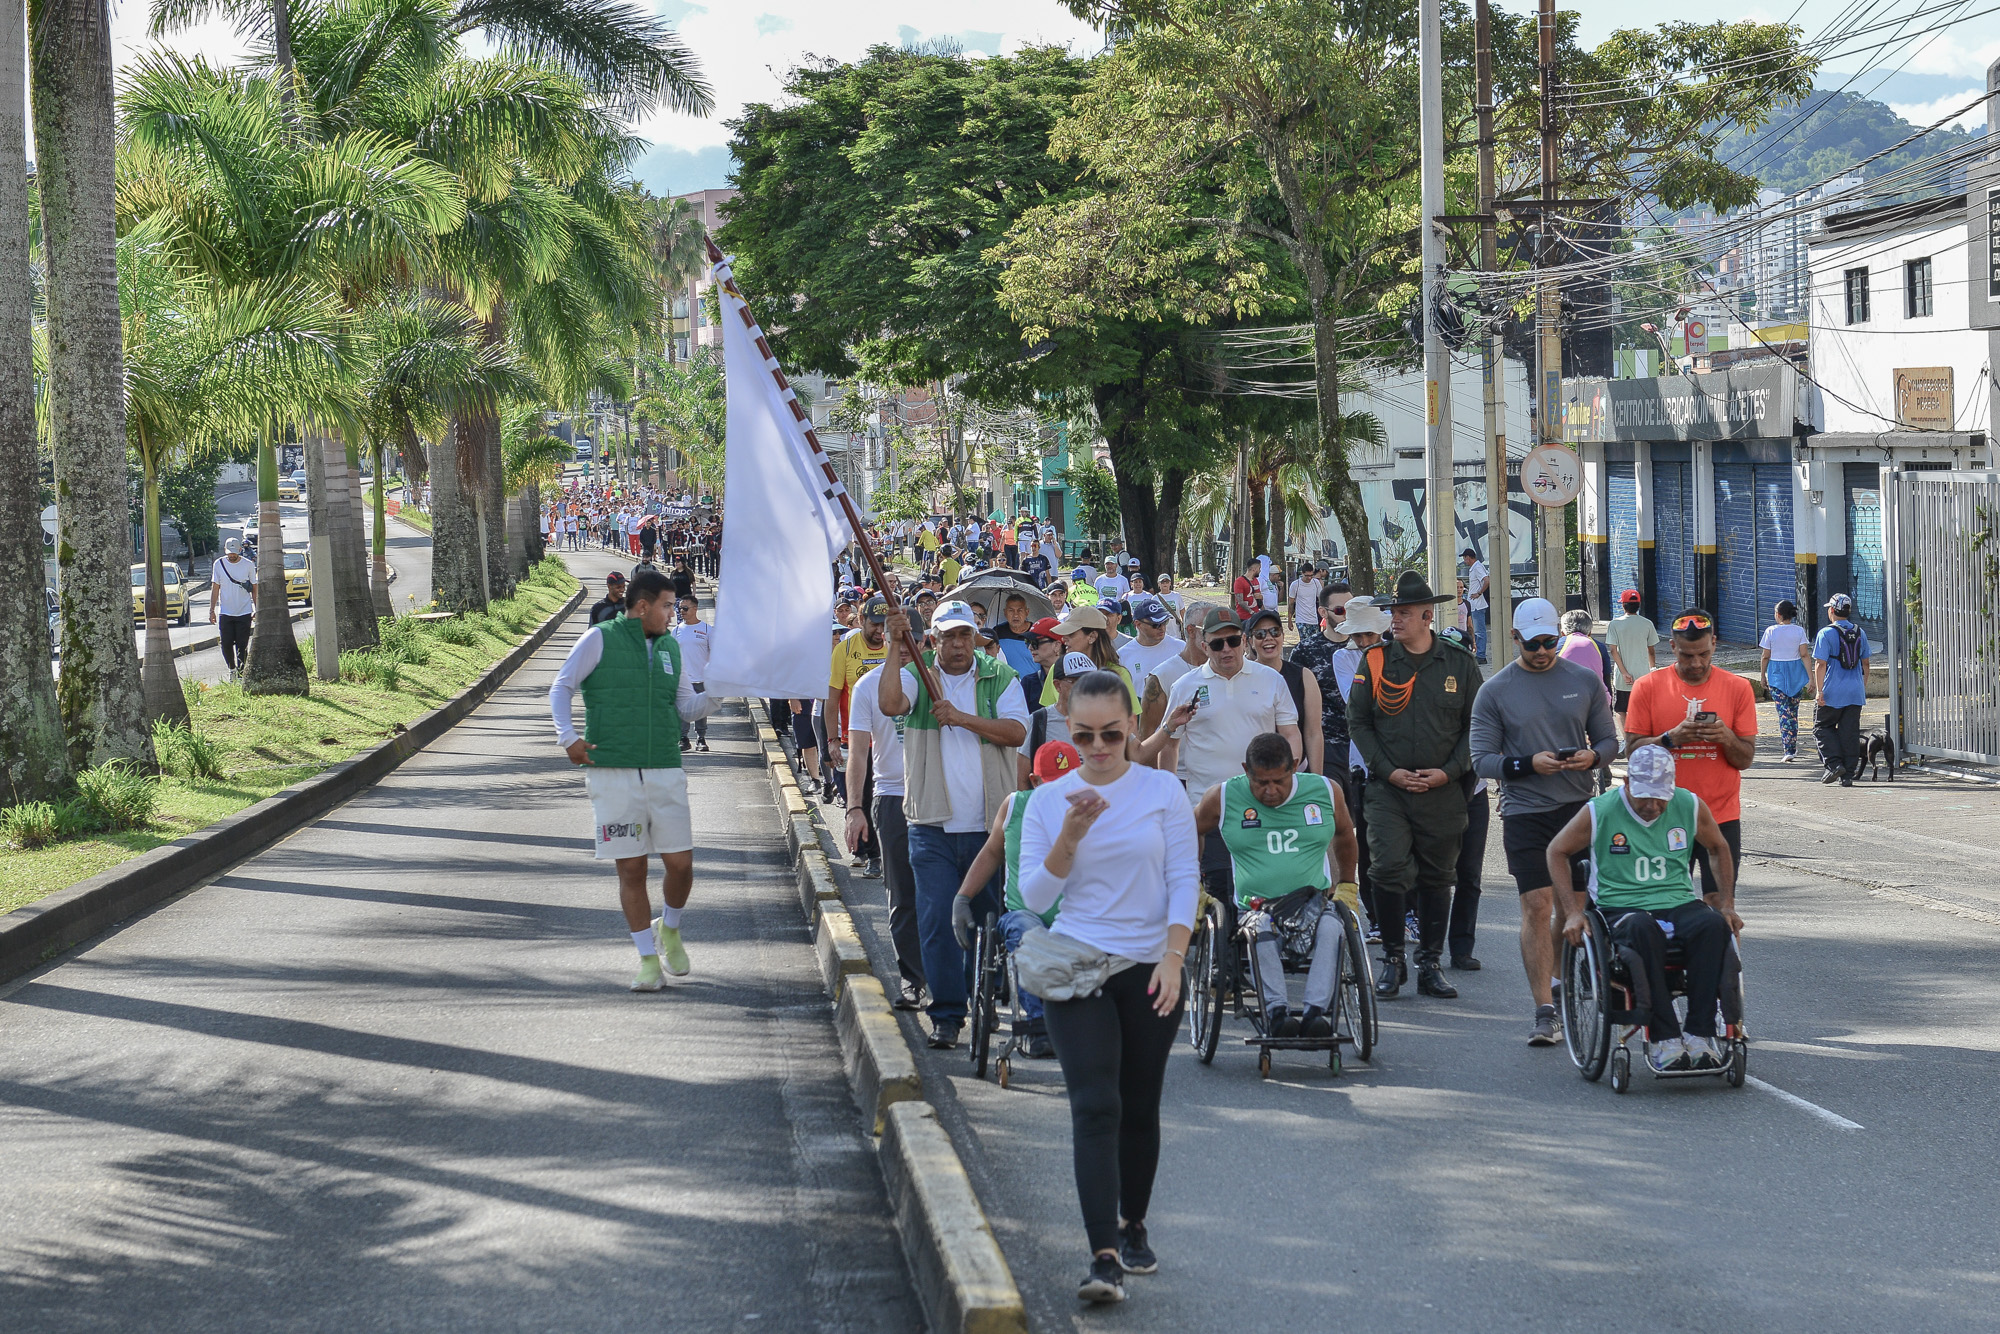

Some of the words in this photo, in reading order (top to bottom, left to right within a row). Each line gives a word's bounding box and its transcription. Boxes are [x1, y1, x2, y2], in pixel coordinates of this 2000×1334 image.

[1615, 399, 1643, 427] CENTRO
[1644, 399, 1655, 426] DE
[1656, 393, 1708, 426] LUBRICACION
[1267, 829, 1299, 854] 02
[1635, 856, 1667, 881] 03
